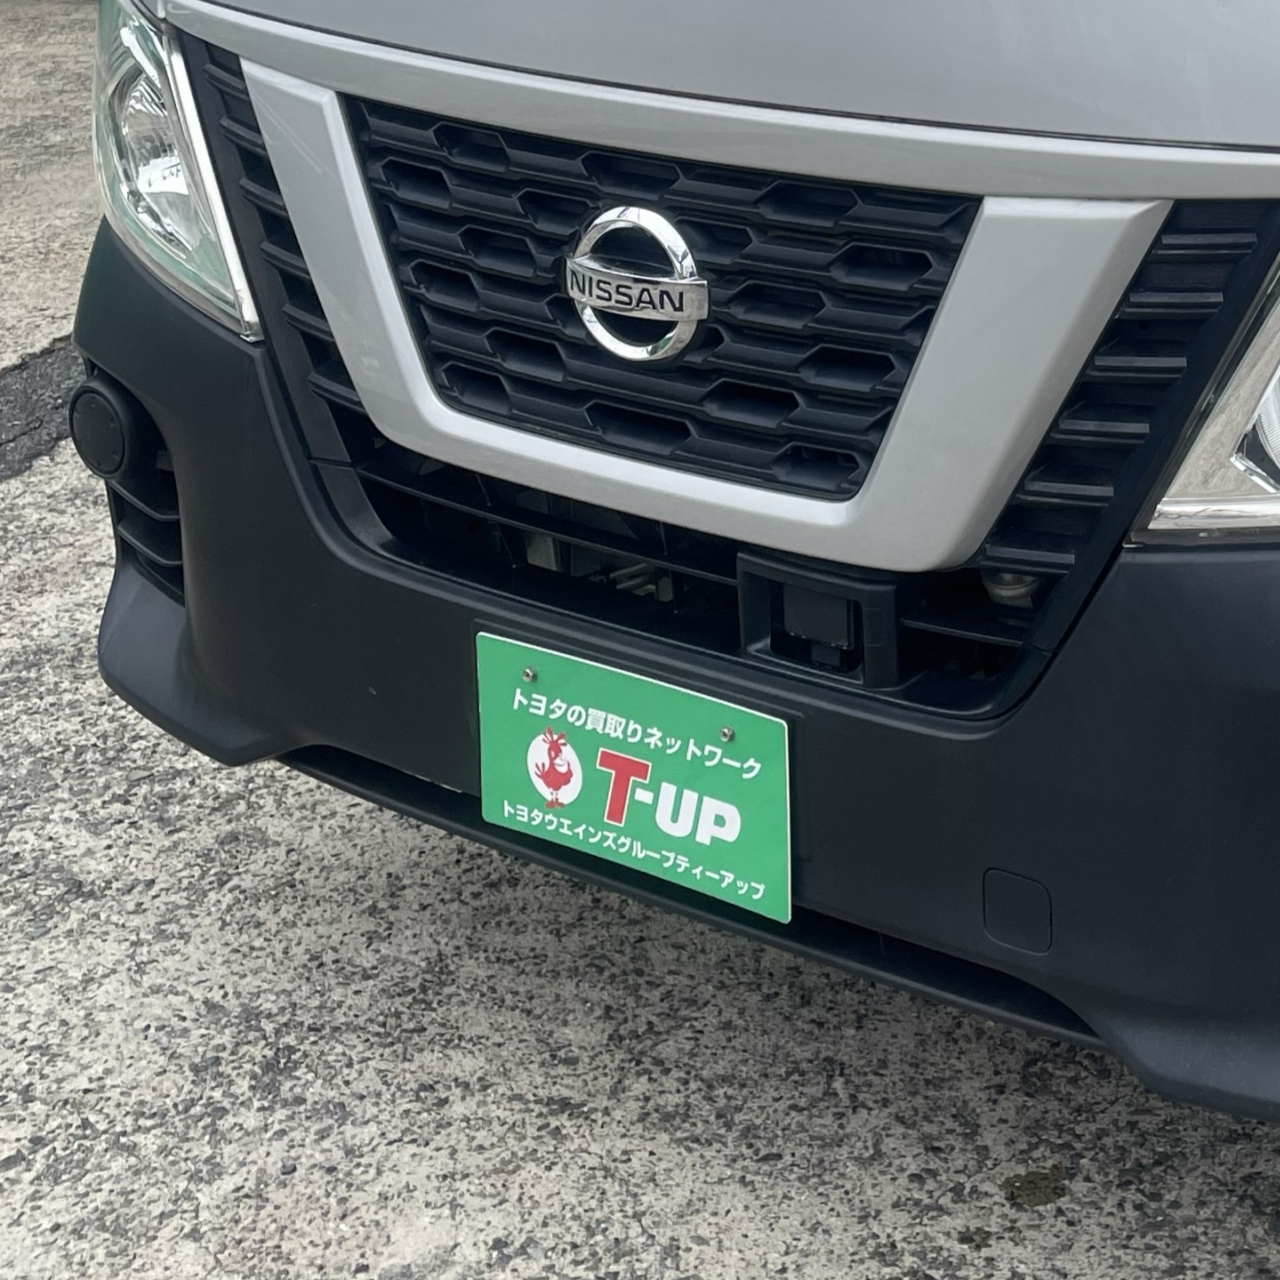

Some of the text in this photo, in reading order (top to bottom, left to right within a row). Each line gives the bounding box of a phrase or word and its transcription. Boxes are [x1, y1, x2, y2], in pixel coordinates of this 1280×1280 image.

[569, 271, 684, 313] NISSAN
[512, 687, 762, 780] トヨタの買取りネットワーク
[596, 747, 742, 846] T-UP
[503, 799, 766, 900] トヨタウエインズグループティーアップ
